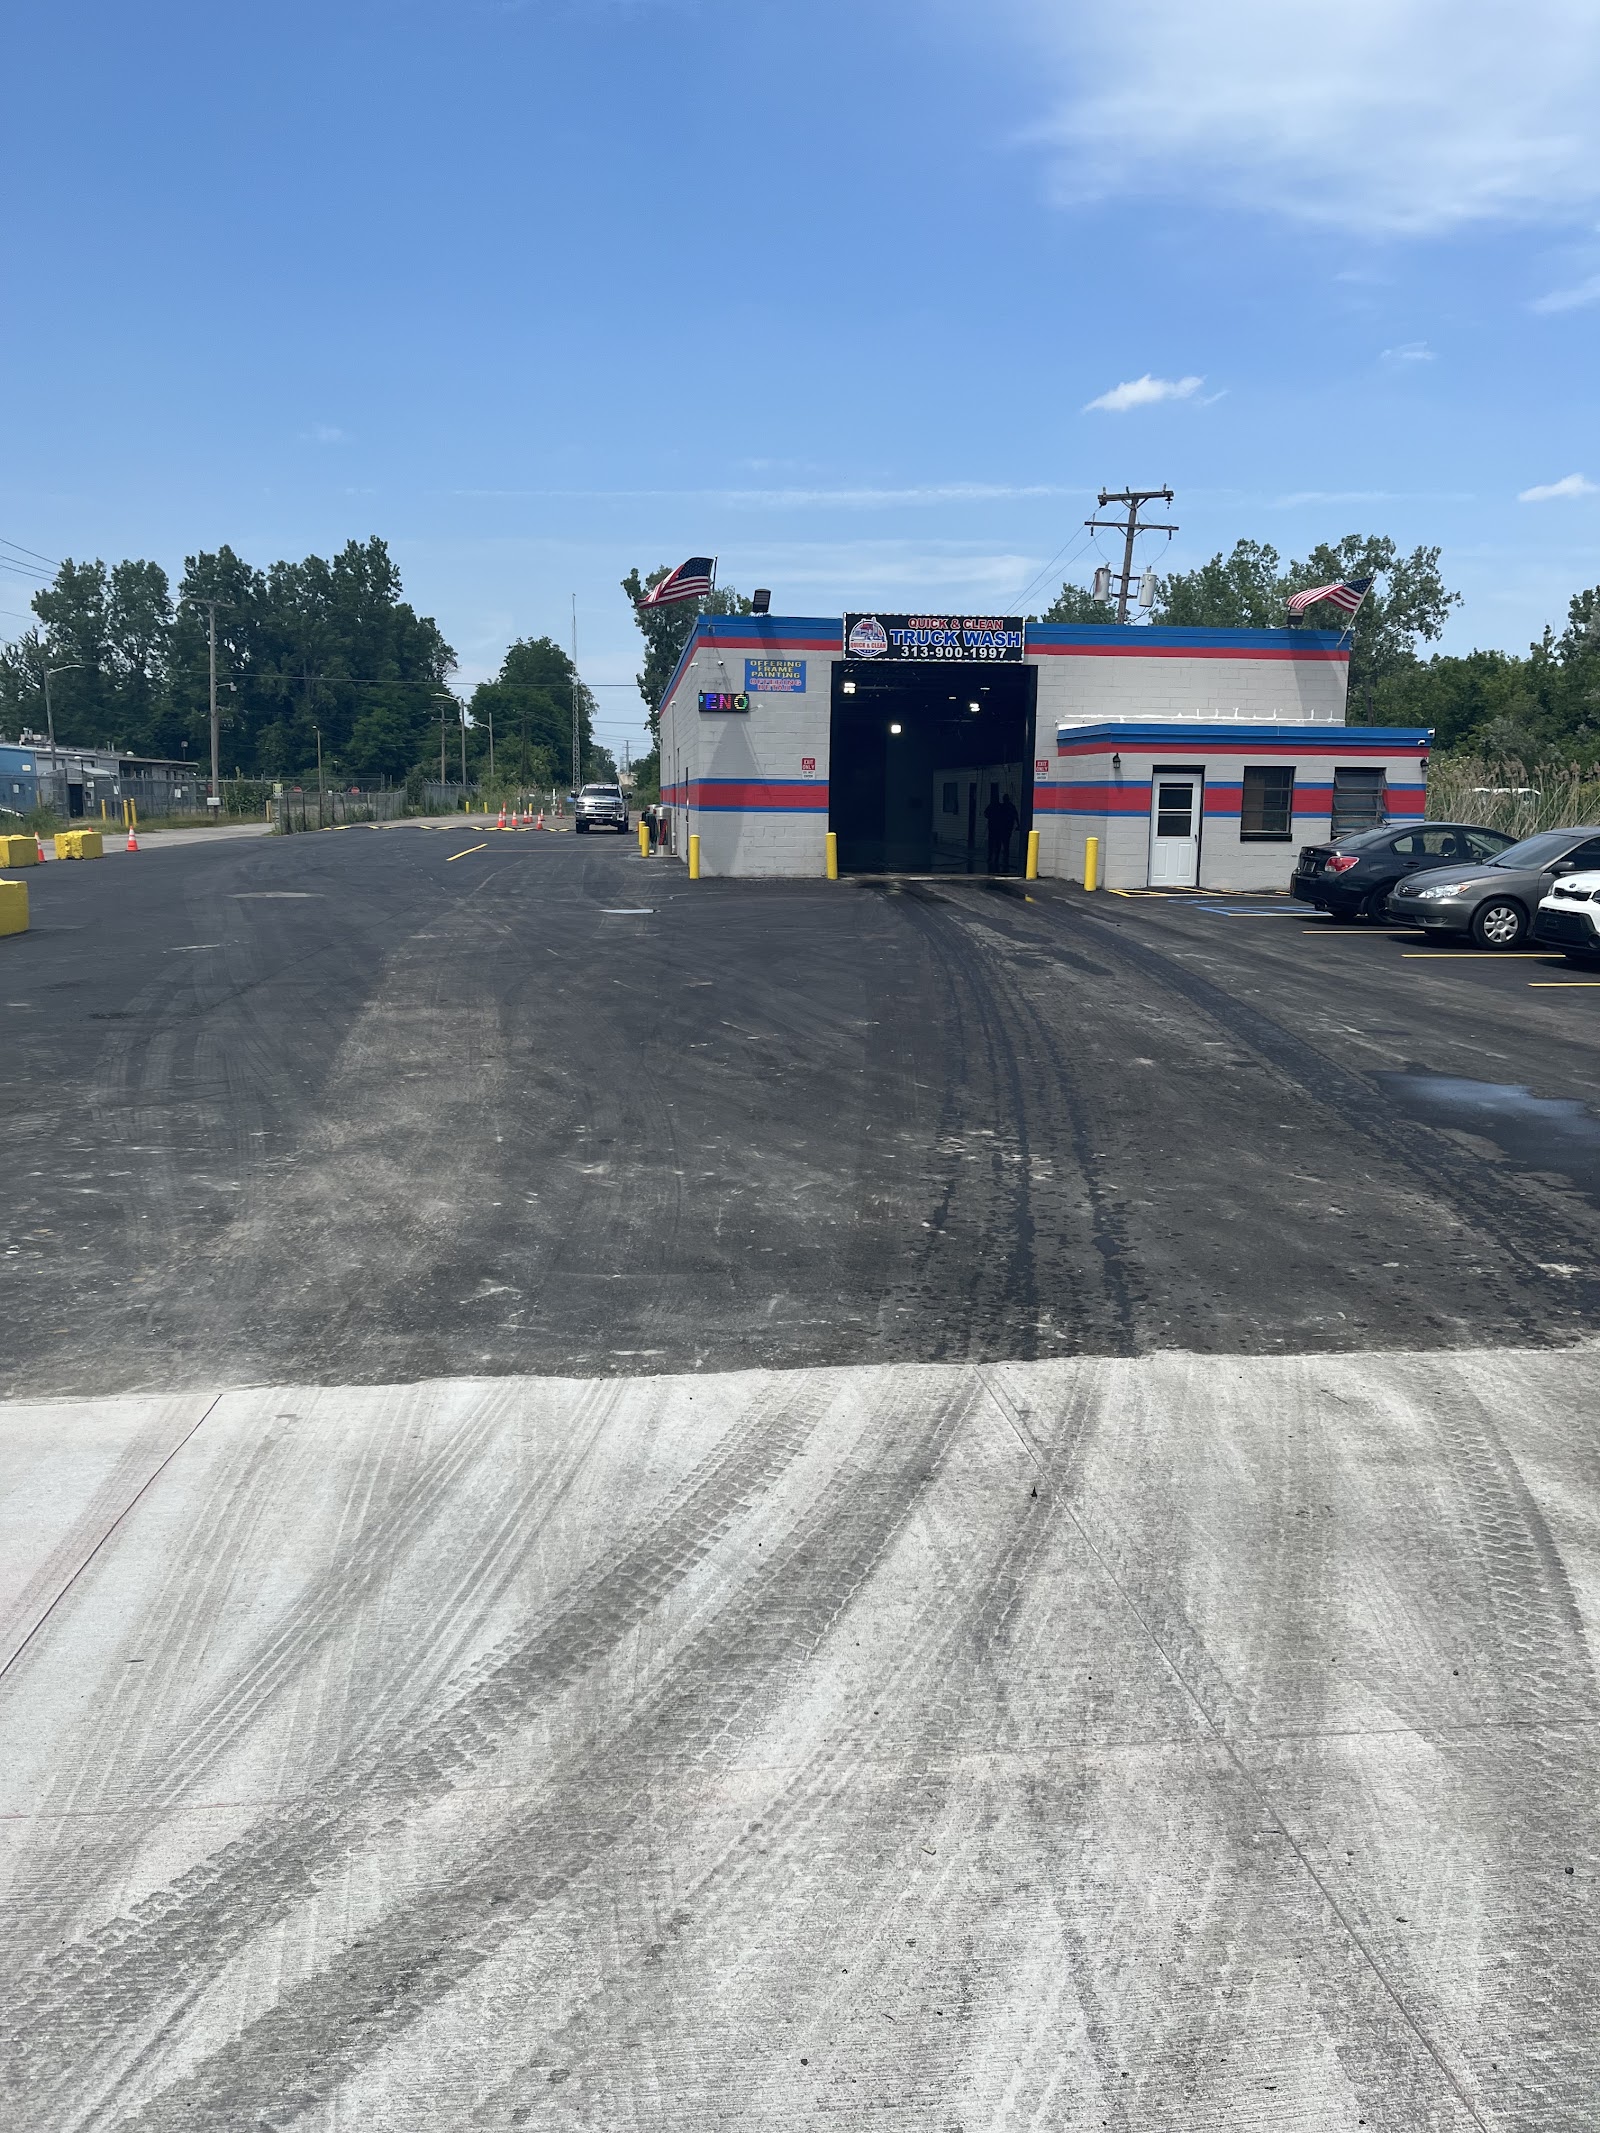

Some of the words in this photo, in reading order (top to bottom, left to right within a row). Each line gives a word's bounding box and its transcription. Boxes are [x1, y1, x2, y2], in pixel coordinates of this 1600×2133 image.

[908, 618, 948, 629] QUICK
[951, 619, 960, 629] &
[963, 619, 1004, 630] CLEAN
[890, 630, 960, 646] TRUCK
[963, 631, 1021, 648] WASH
[901, 647, 1006, 658] 313-900-1997
[750, 660, 802, 668] OFFERING
[751, 671, 800, 679] PAINTING
[749, 678, 802, 686] OFFERING
